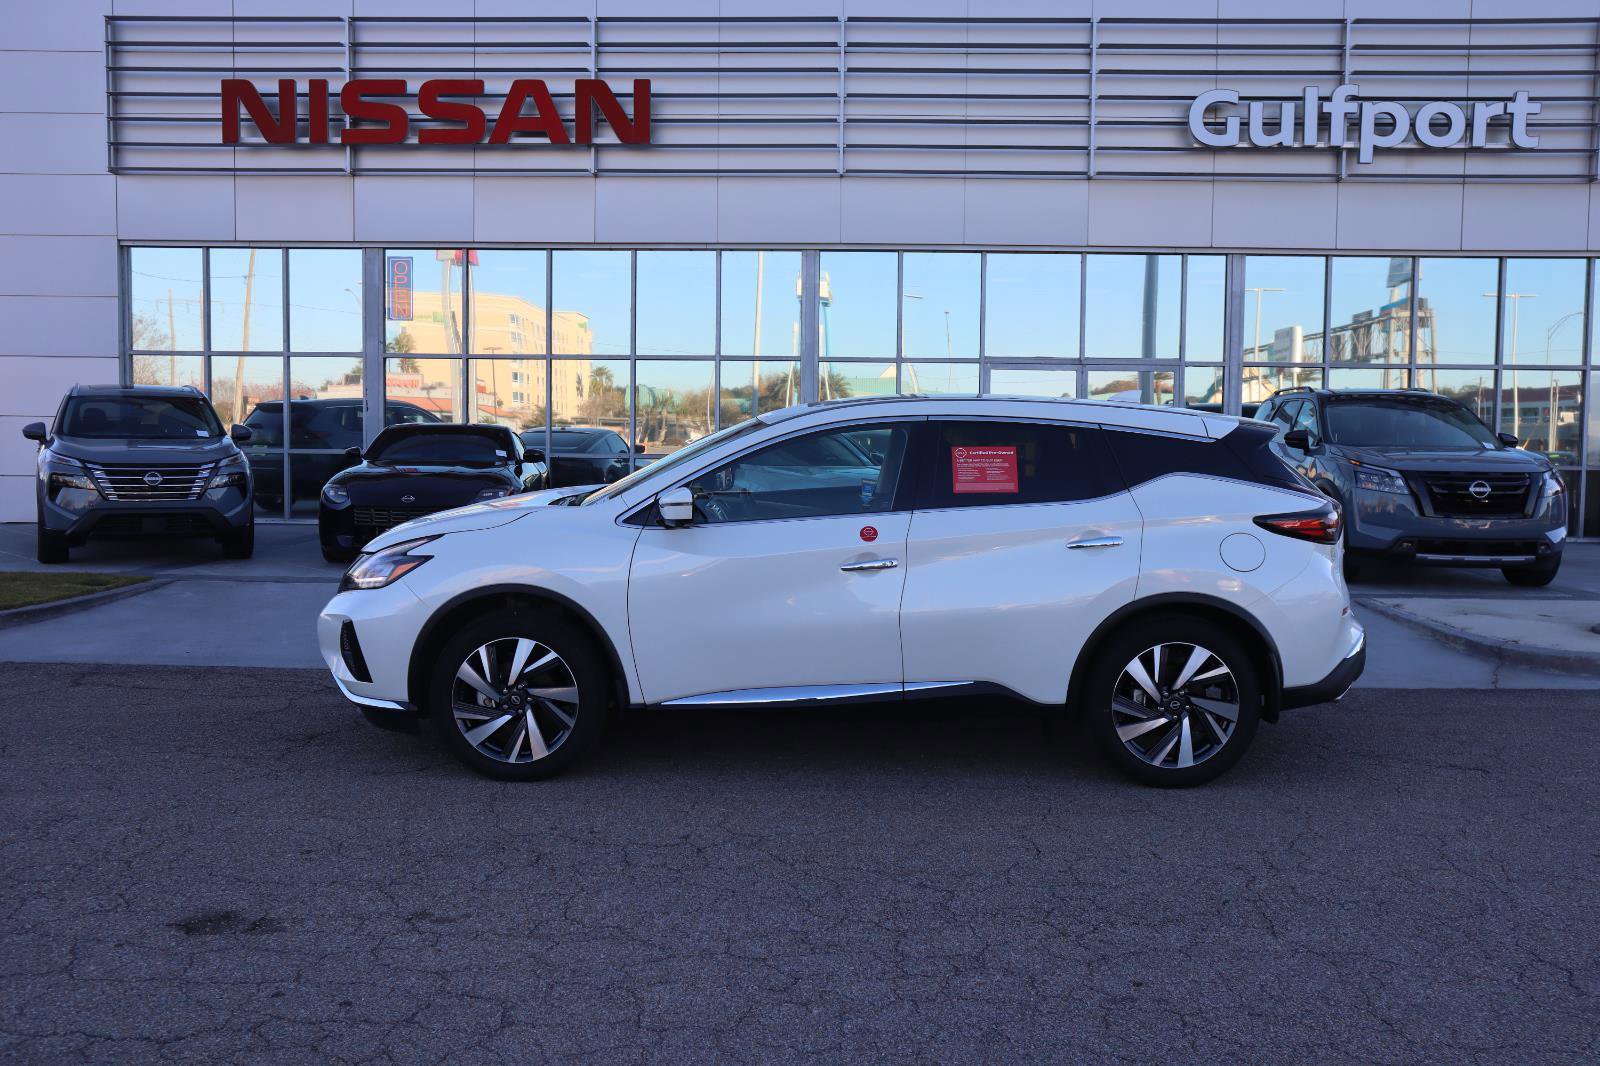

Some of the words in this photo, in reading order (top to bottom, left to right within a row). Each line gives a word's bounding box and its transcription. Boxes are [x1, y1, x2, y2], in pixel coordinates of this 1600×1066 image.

[221, 79, 651, 144] NISSAN
[1188, 84, 1542, 164] Gulfport
[393, 260, 410, 318] OPEN
